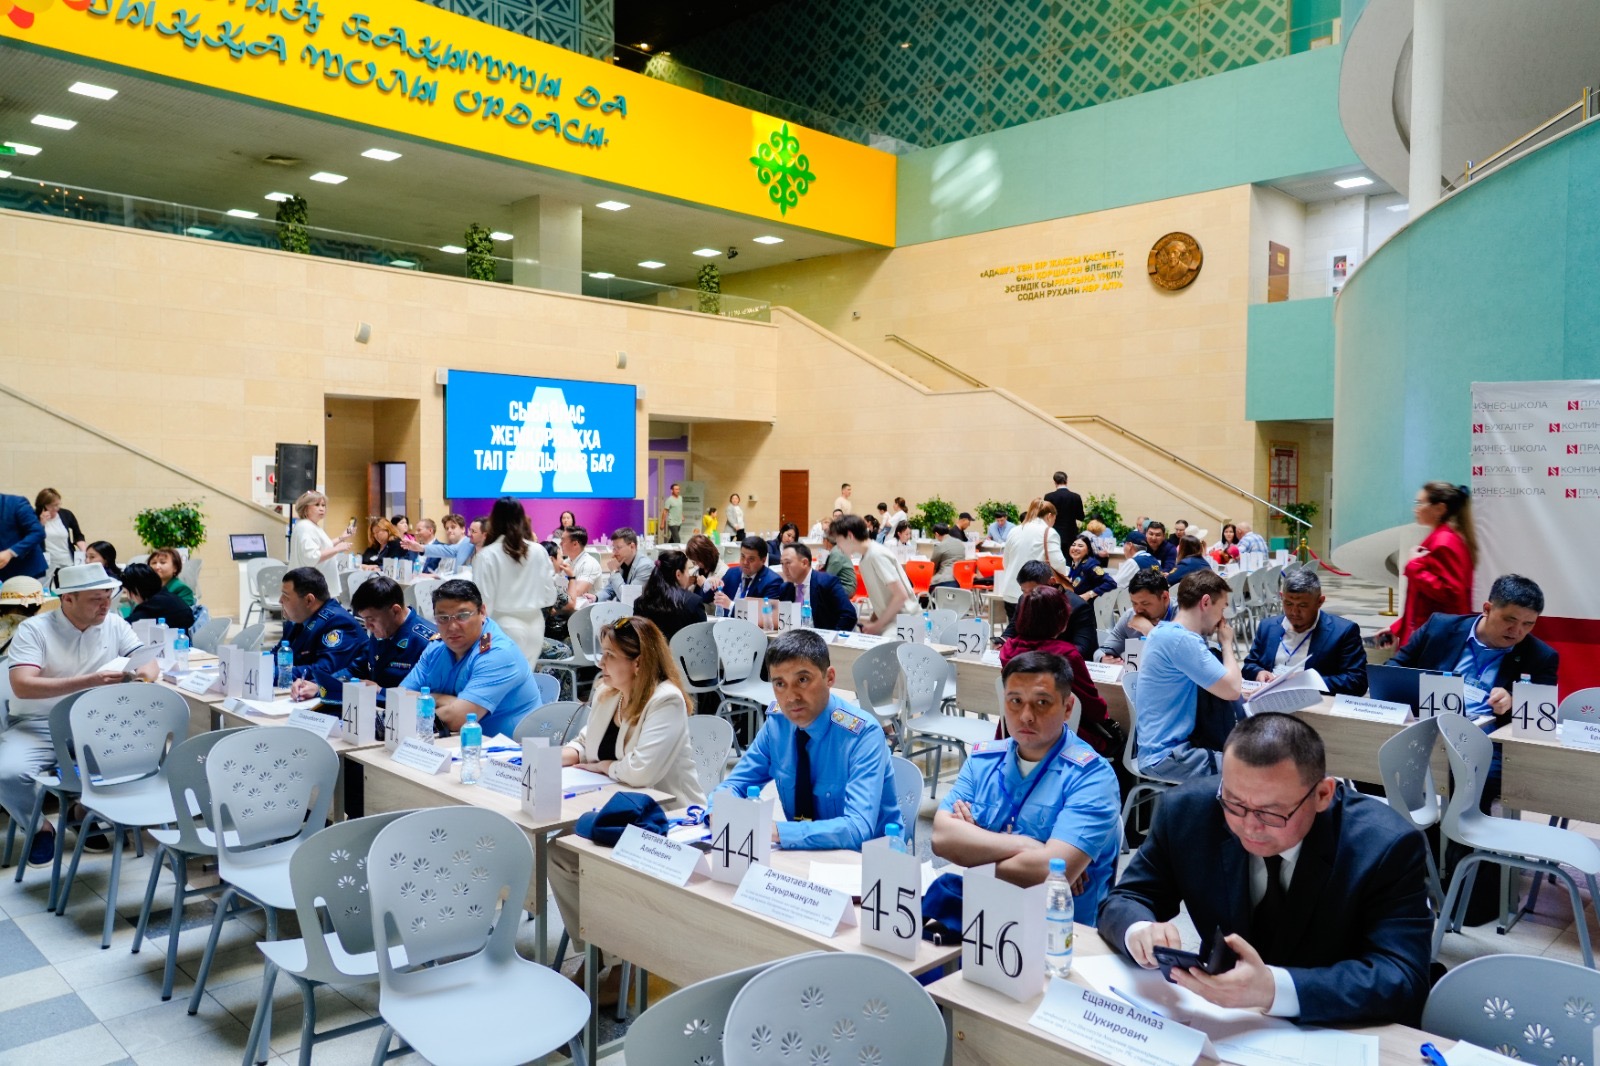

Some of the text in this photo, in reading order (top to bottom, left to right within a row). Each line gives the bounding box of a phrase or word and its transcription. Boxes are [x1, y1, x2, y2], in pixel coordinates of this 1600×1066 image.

[300, 43, 438, 103] ТОЛЫ
[574, 85, 628, 116] ДА
[1017, 290, 1045, 301] СОДАН
[1484, 423, 1534, 431] БУХГАЛТЕР
[474, 449, 503, 471] ТАП
[590, 453, 615, 473] БА?
[1484, 466, 1533, 474] БУХГАЛТЕР
[778, 613, 793, 630] 54
[957, 633, 981, 654] 52
[342, 702, 358, 736] 41
[1419, 691, 1462, 717] 49
[1511, 700, 1557, 732] 48
[711, 821, 760, 869] 44
[764, 868, 833, 897] Джуматаев Алмас
[860, 878, 917, 940] 45
[961, 908, 1023, 979] 46
[1082, 989, 1165, 1031] Ещанов Алмаз
[1082, 1009, 1150, 1044] Шукирович
